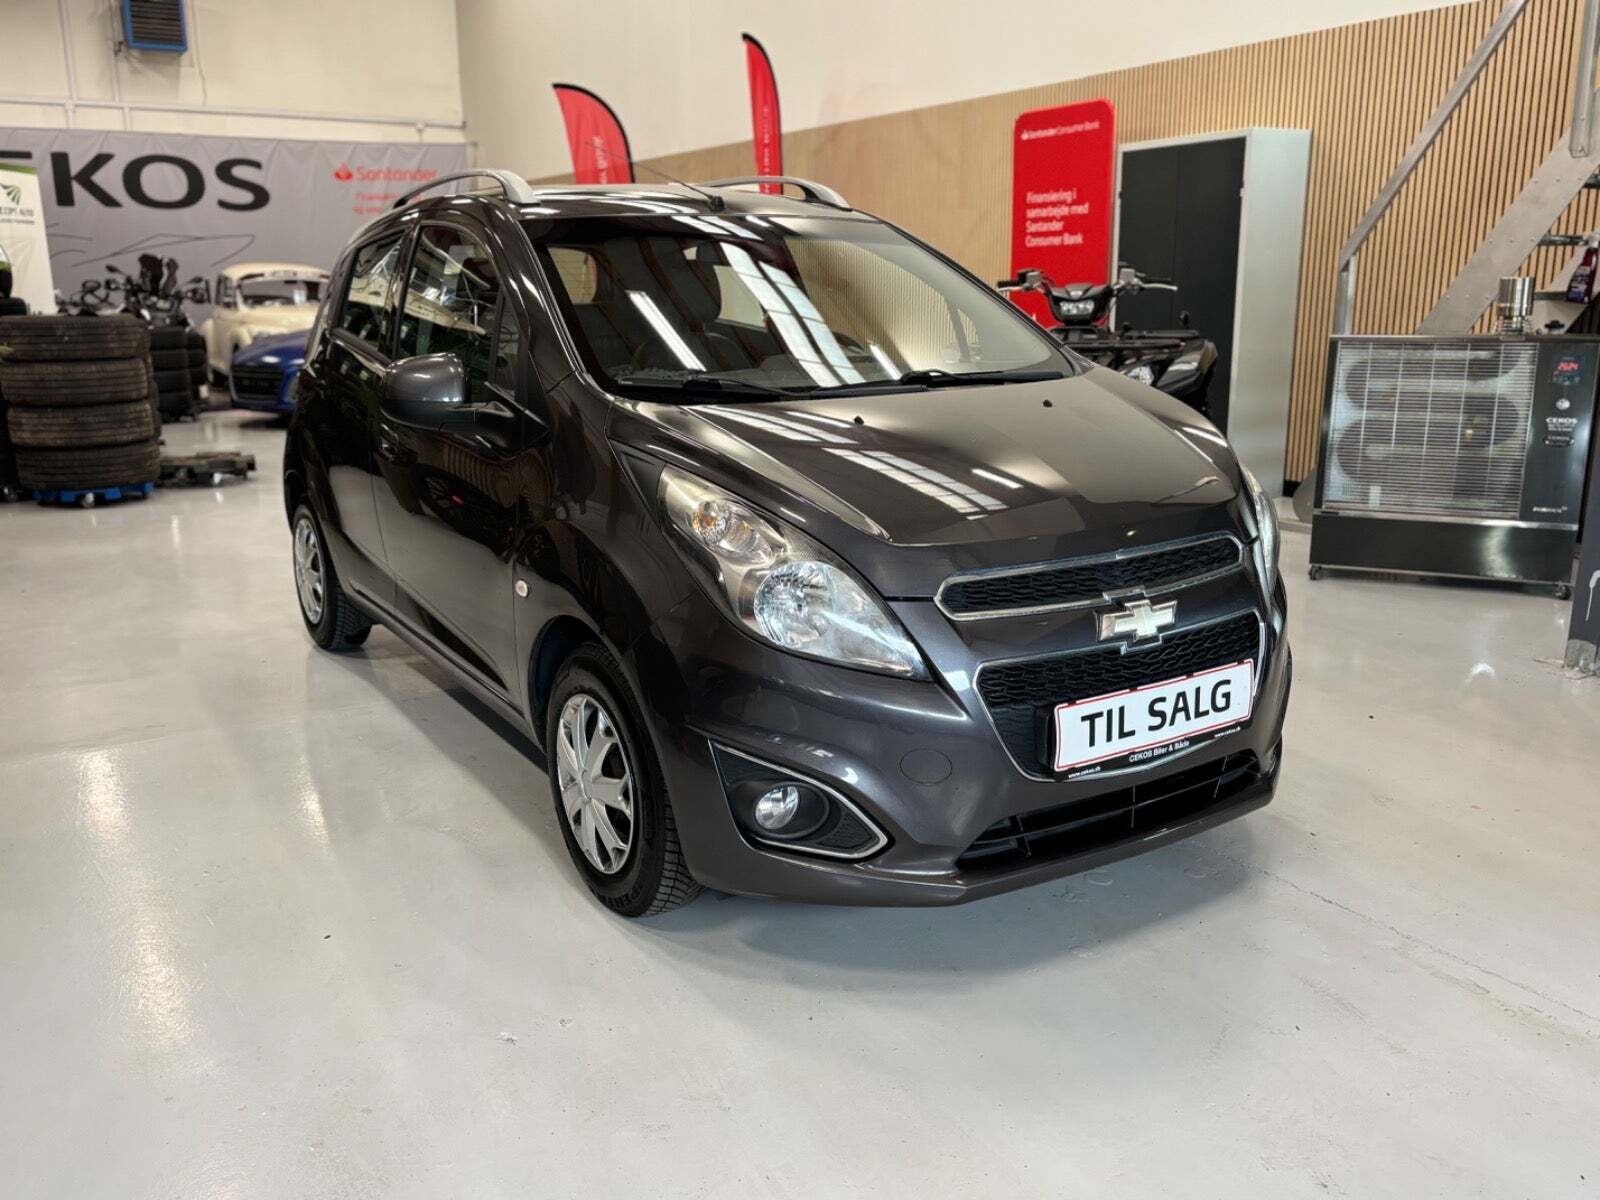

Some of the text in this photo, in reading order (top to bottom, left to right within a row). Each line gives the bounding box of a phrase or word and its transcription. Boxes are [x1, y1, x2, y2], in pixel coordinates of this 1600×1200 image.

[0, 151, 271, 212] KOS
[355, 165, 437, 182] Santander
[1070, 202, 1090, 214] med
[1025, 220, 1064, 233] Santander
[1025, 233, 1083, 248] Consumer Bank
[1080, 679, 1232, 748] TIL SALG
